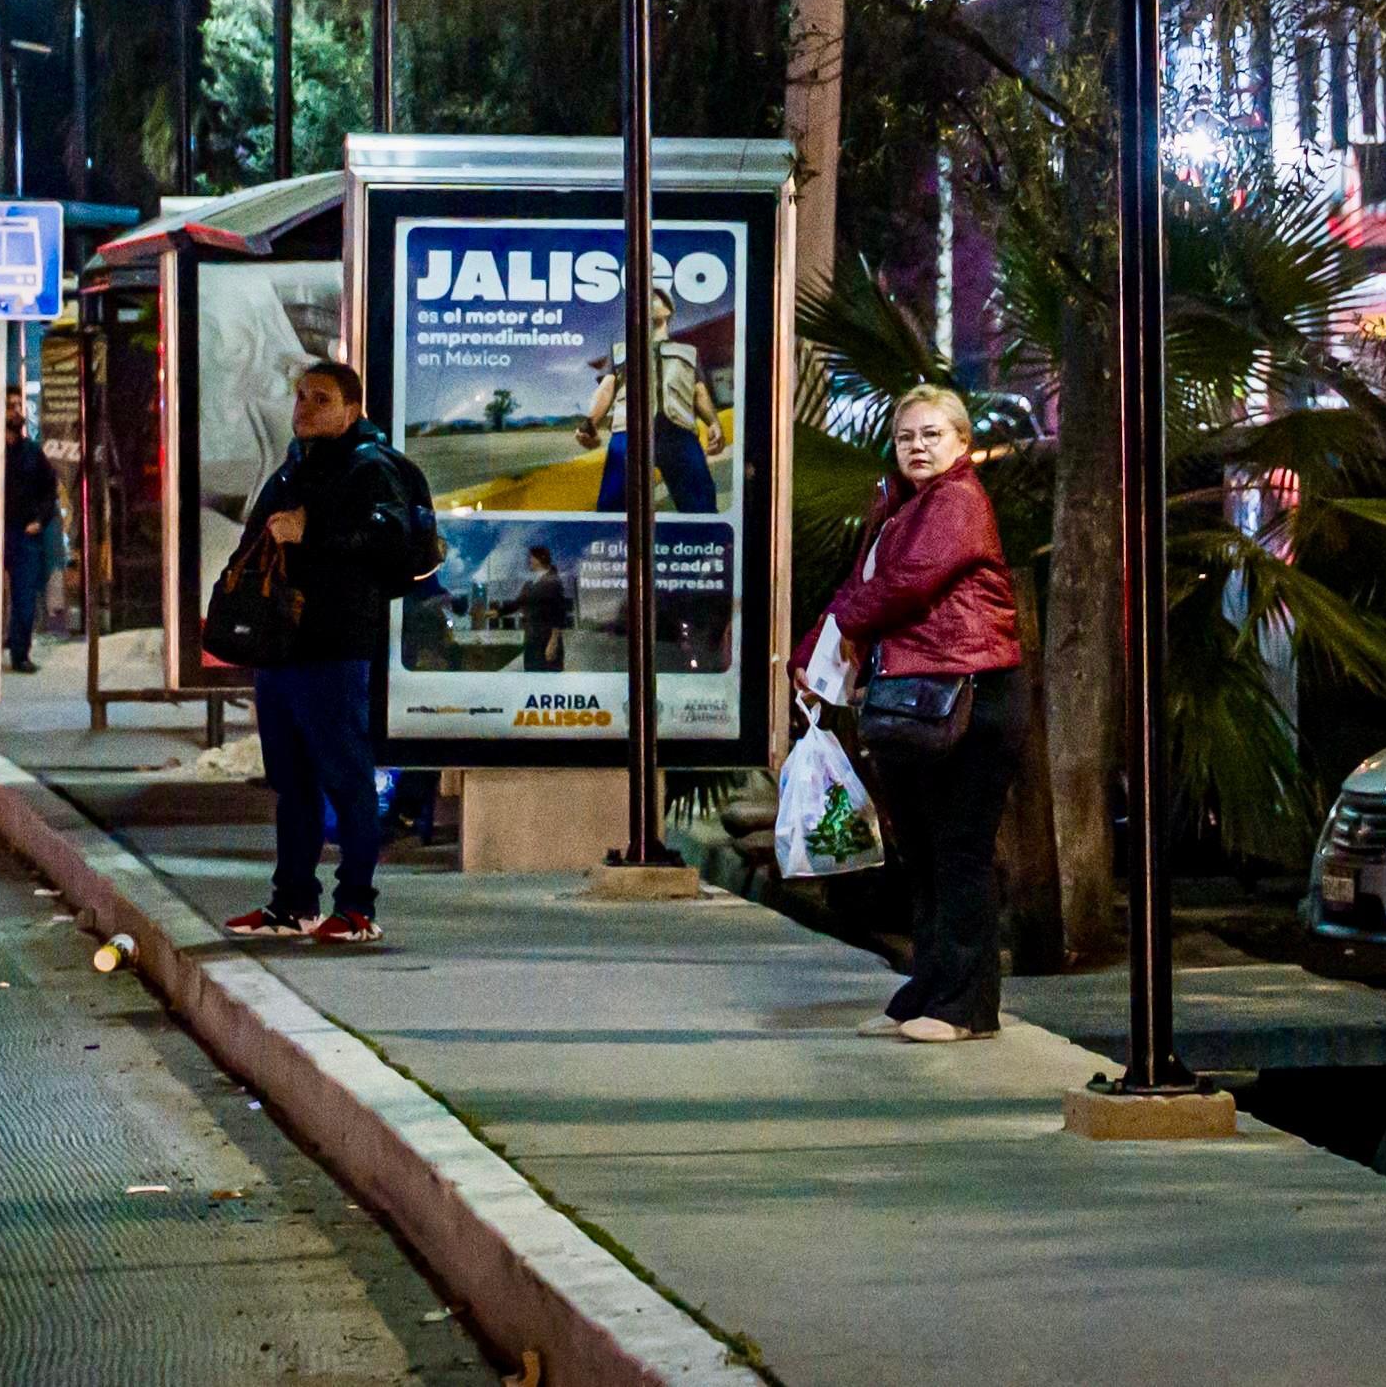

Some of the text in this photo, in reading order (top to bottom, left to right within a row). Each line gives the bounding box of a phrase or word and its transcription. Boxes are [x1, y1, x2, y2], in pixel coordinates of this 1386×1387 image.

[417, 308, 563, 325] es el motor del
[417, 328, 584, 348] emprendimiento
[417, 350, 511, 366] en México
[672, 541, 725, 555] donde
[669, 559, 711, 572] cada
[654, 578, 725, 592] mpresas
[524, 694, 600, 709] ARRIBA
[513, 709, 612, 727] JALISCO
